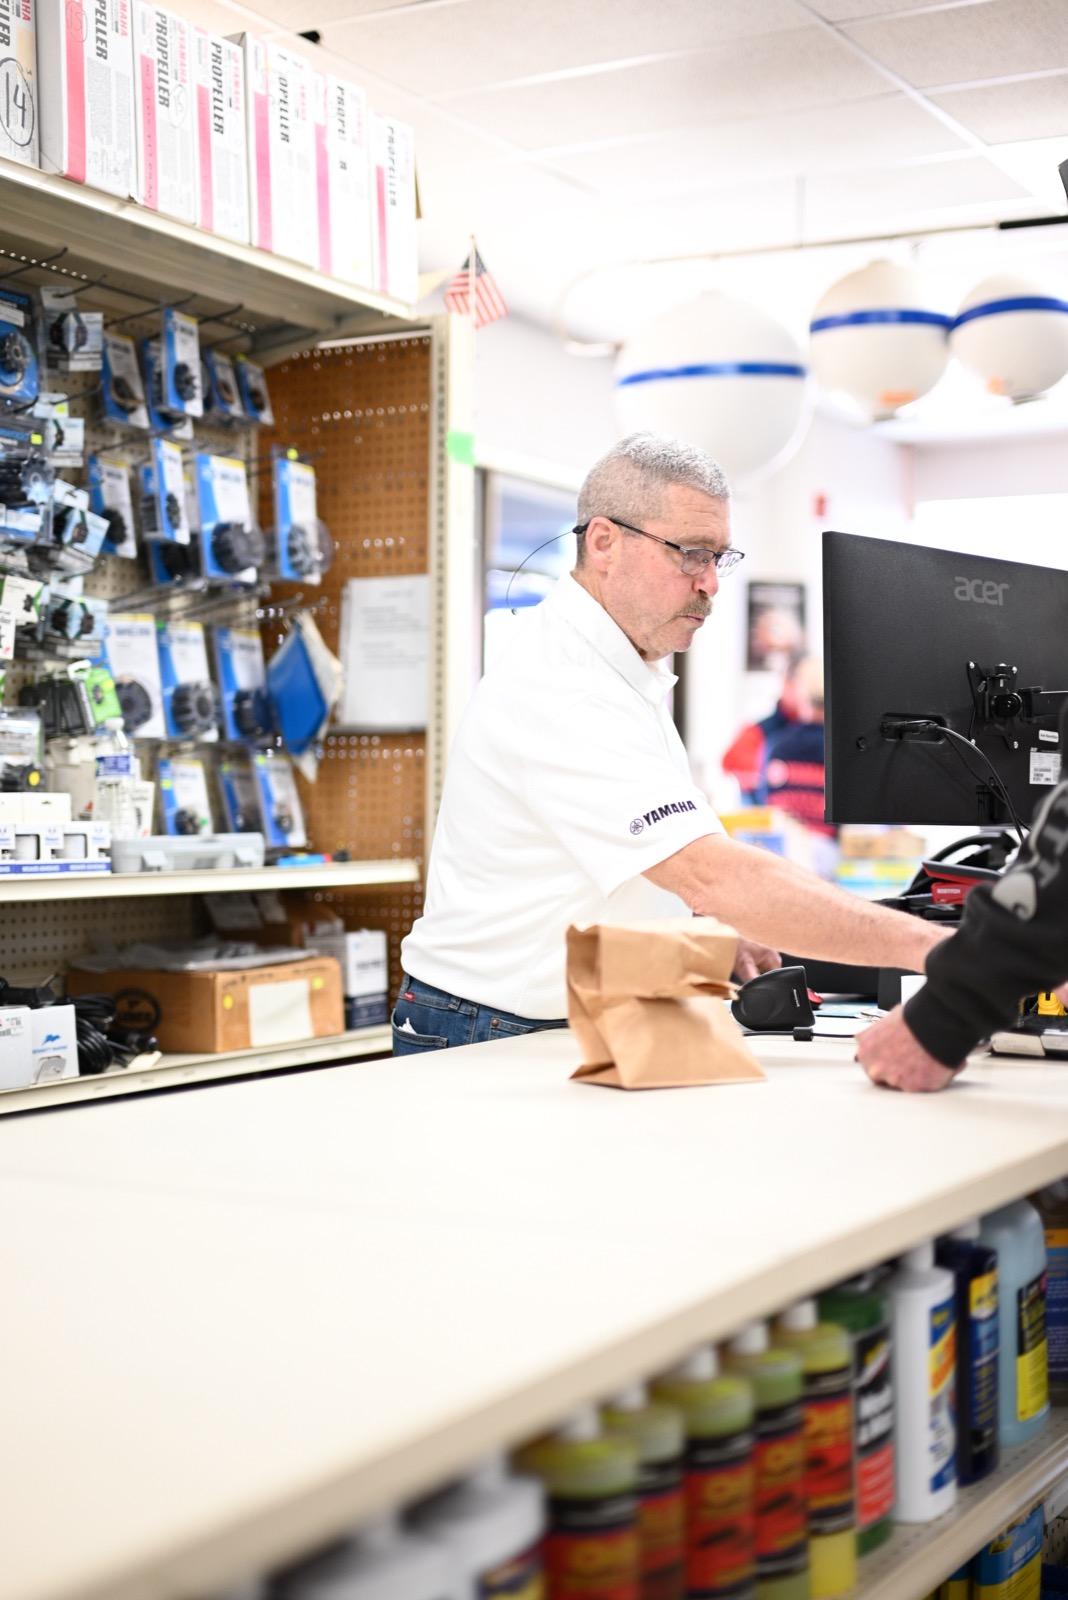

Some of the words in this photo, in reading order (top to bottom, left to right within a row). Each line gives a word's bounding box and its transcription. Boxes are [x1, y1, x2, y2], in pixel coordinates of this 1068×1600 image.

[119, 0, 128, 36] MAHA
[155, 11, 170, 108] PROPELLER
[211, 42, 224, 134] PROPELLER
[6, 71, 27, 129] 14
[337, 86, 348, 170] PROPER
[954, 576, 1009, 606] acer
[643, 800, 697, 826] YAMAHA
